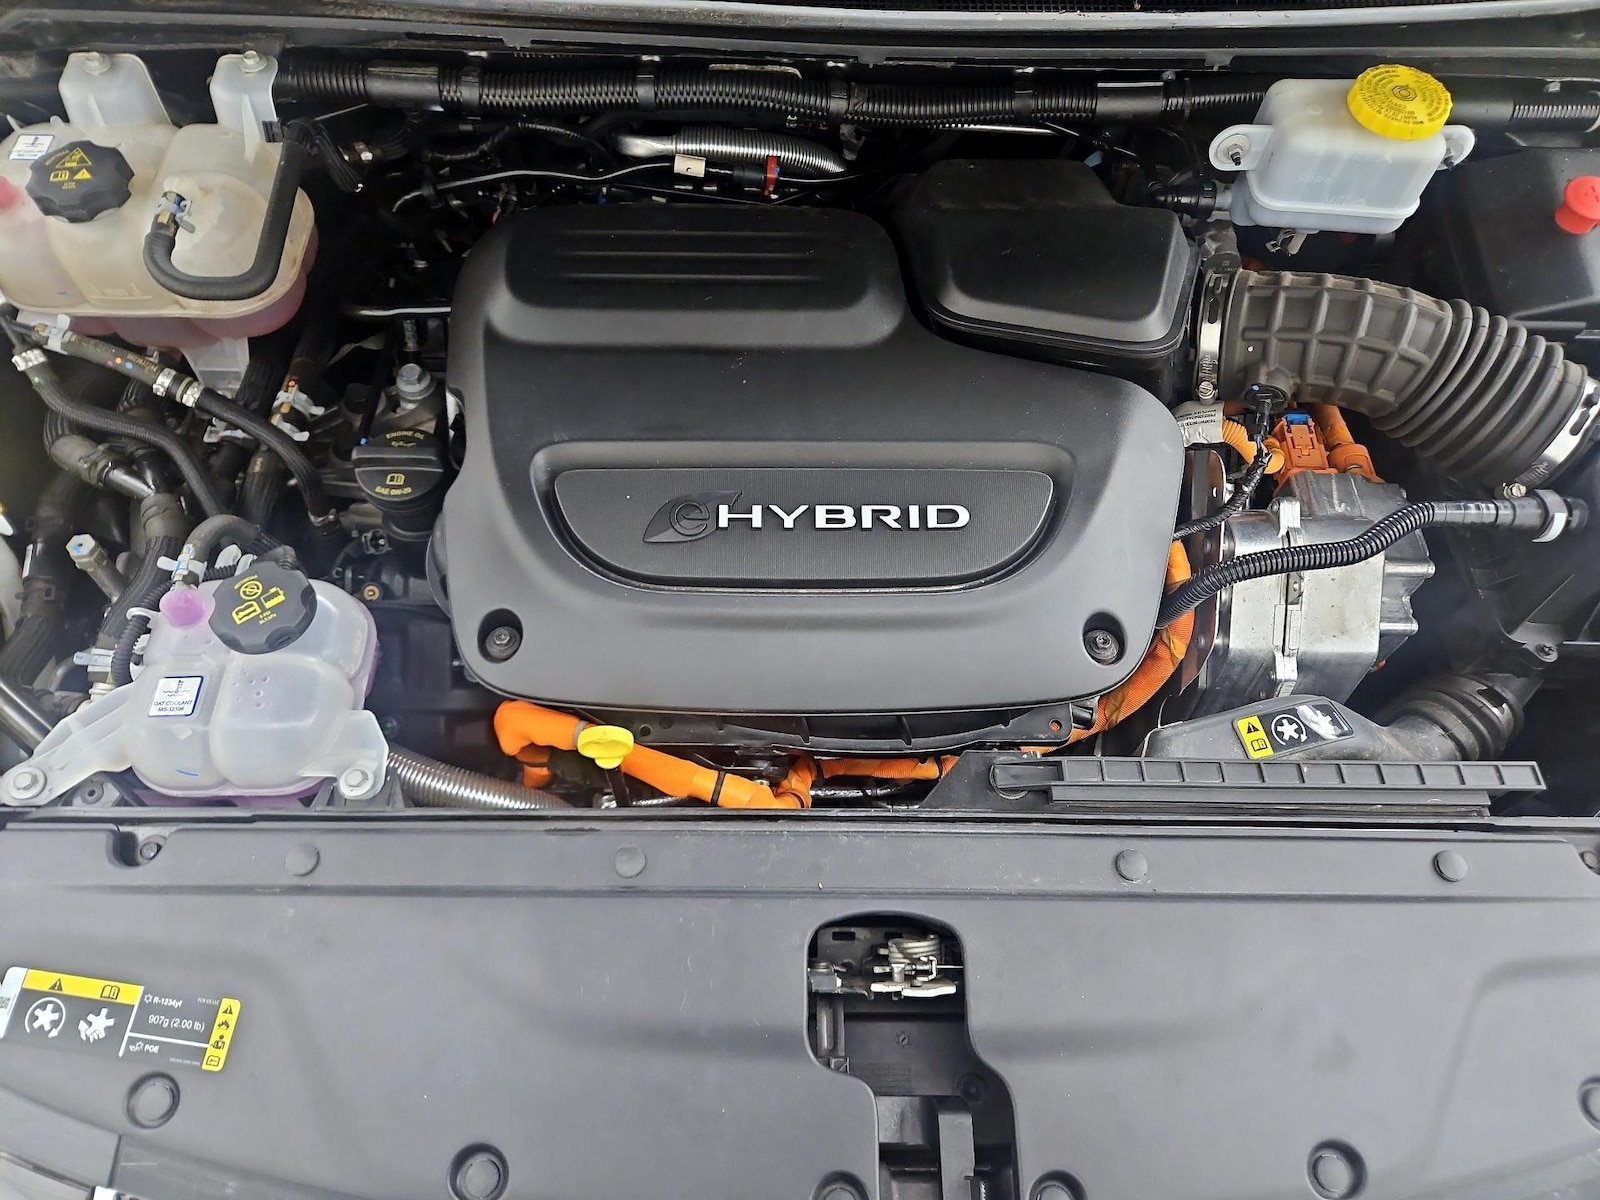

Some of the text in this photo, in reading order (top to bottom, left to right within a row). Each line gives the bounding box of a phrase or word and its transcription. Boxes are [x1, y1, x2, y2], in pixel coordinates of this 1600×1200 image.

[386, 430, 425, 440] ENGINE OIL
[375, 485, 389, 495] SAE
[153, 996, 182, 1008] R-1234yf
[148, 1014, 205, 1032] 907g (2.00 lb)
[144, 1044, 159, 1053] POE
